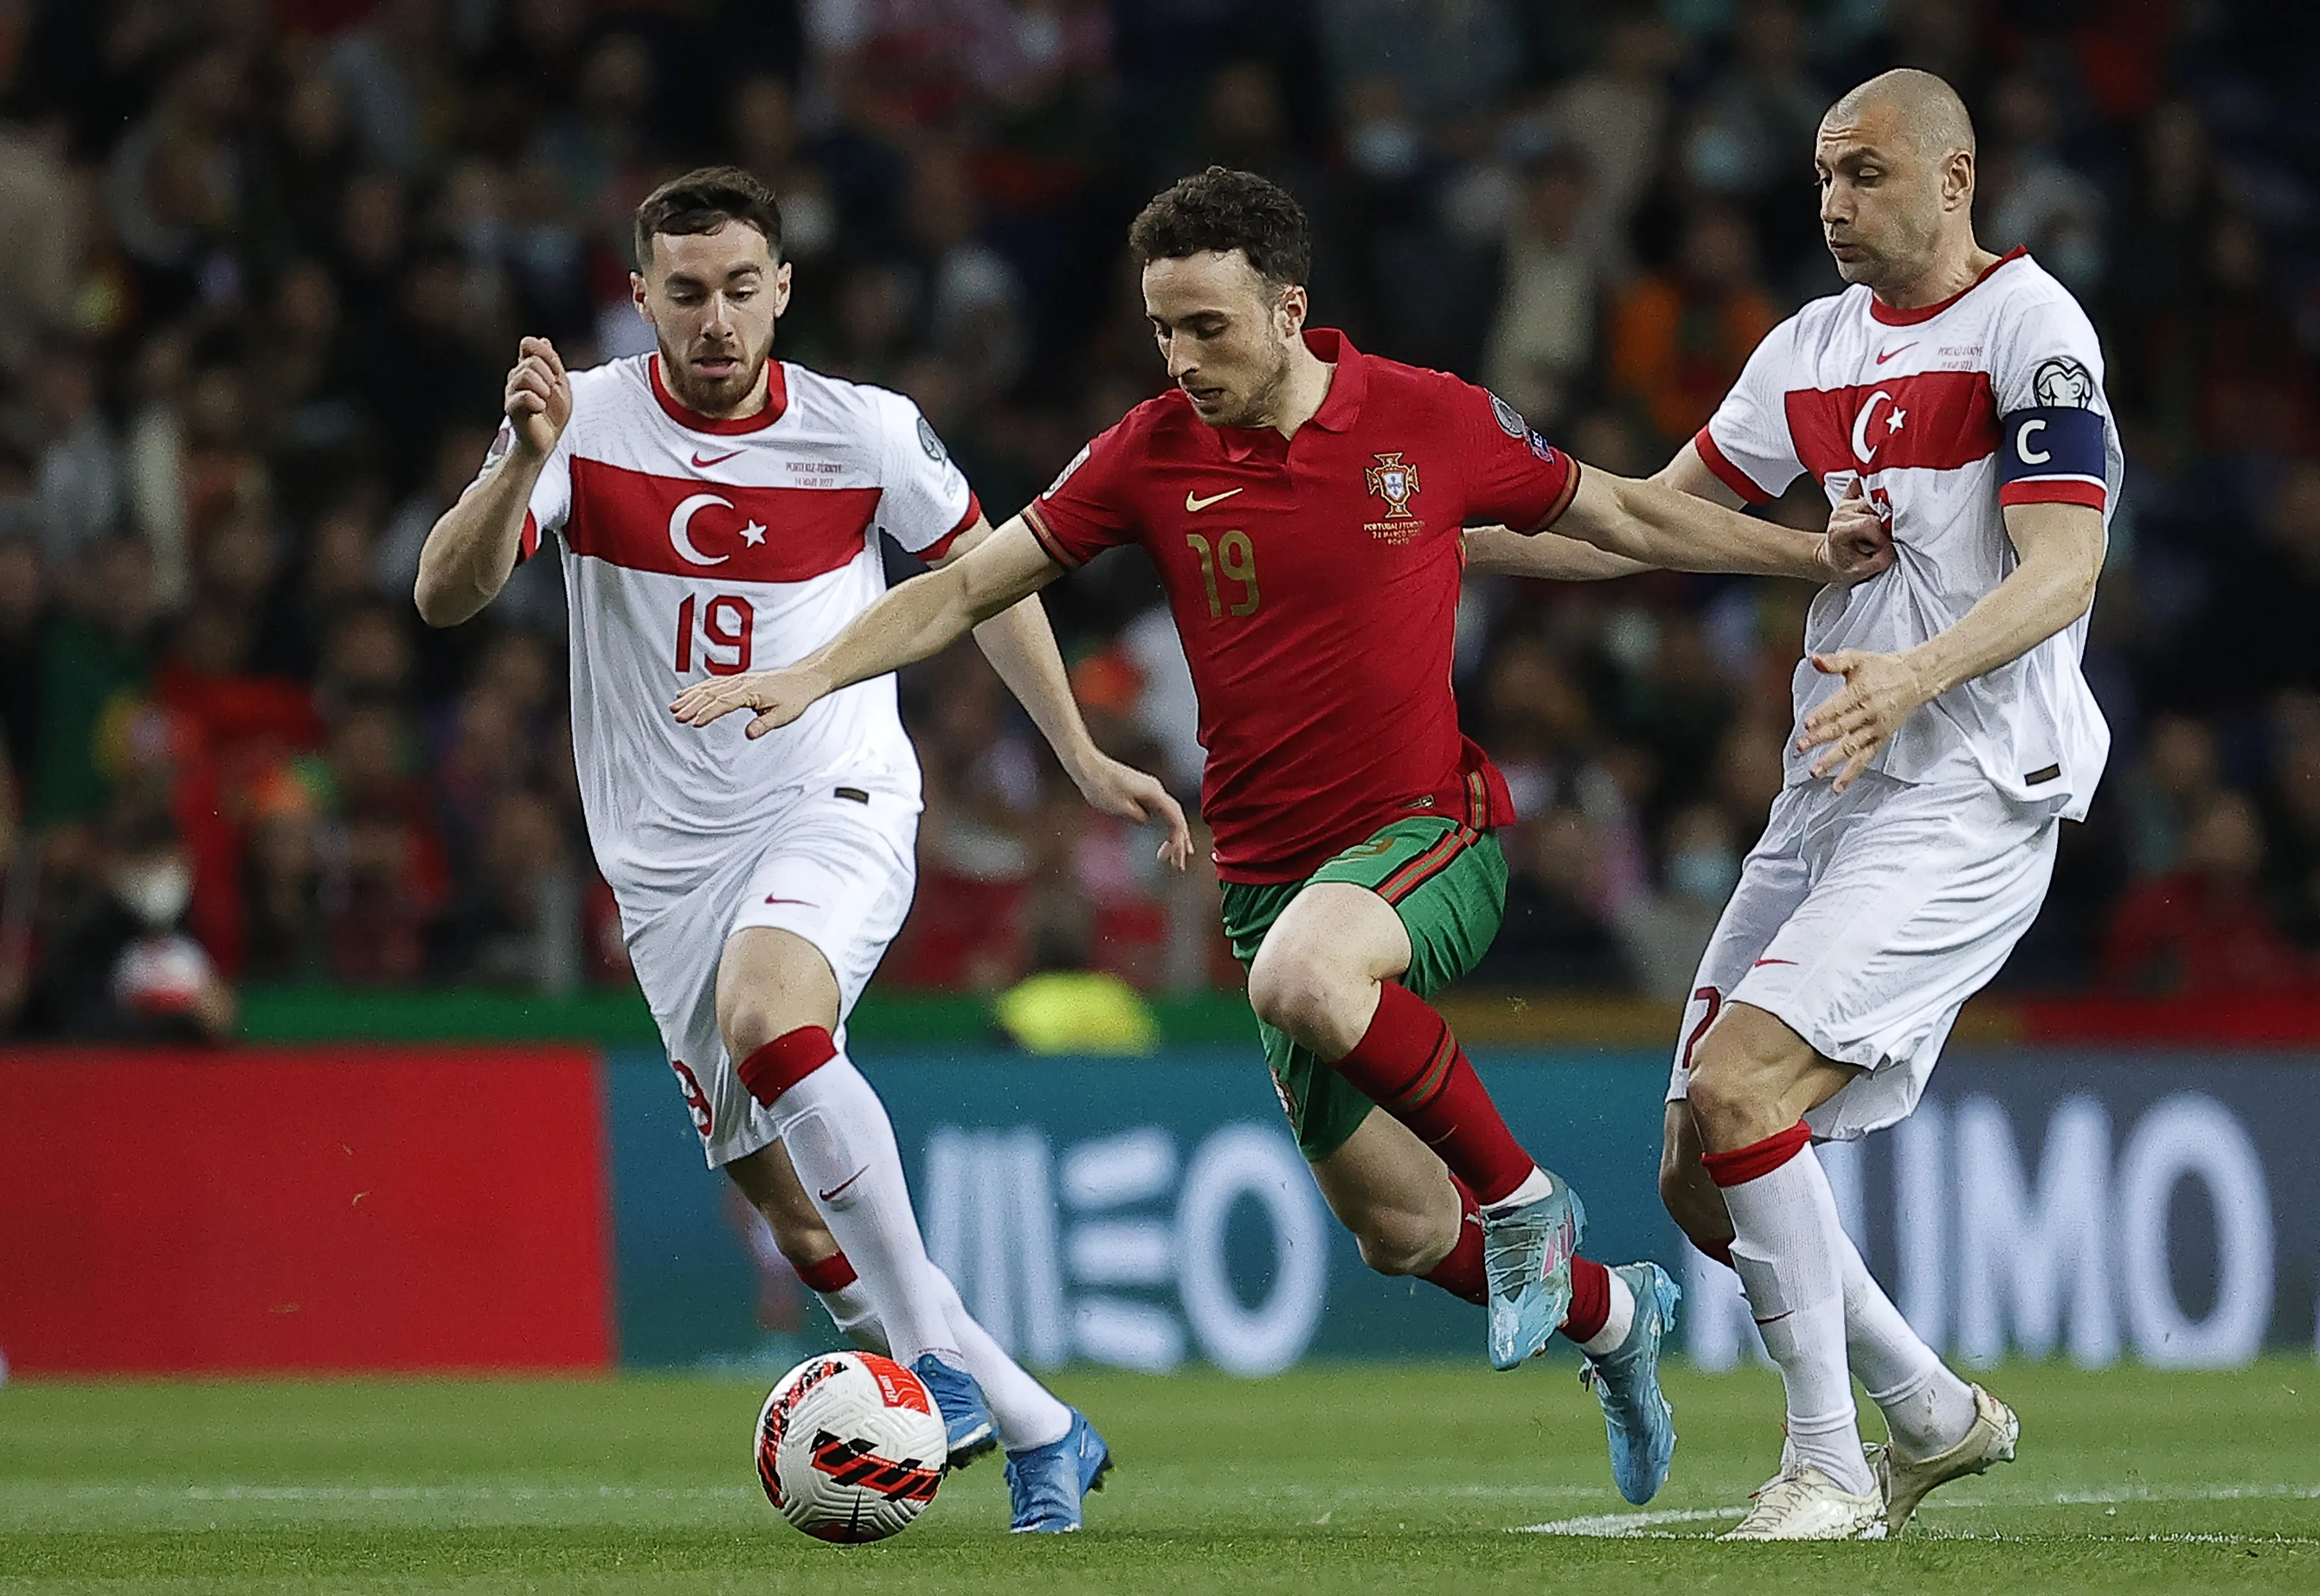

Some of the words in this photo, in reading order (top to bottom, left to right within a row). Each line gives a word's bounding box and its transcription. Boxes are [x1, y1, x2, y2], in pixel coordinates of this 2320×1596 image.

[2017, 419, 2051, 465] C
[1187, 530, 1259, 618] 19
[675, 592, 754, 676] 19
[925, 1123, 1328, 1377] MEO
[1686, 1090, 2278, 1371] UMO
